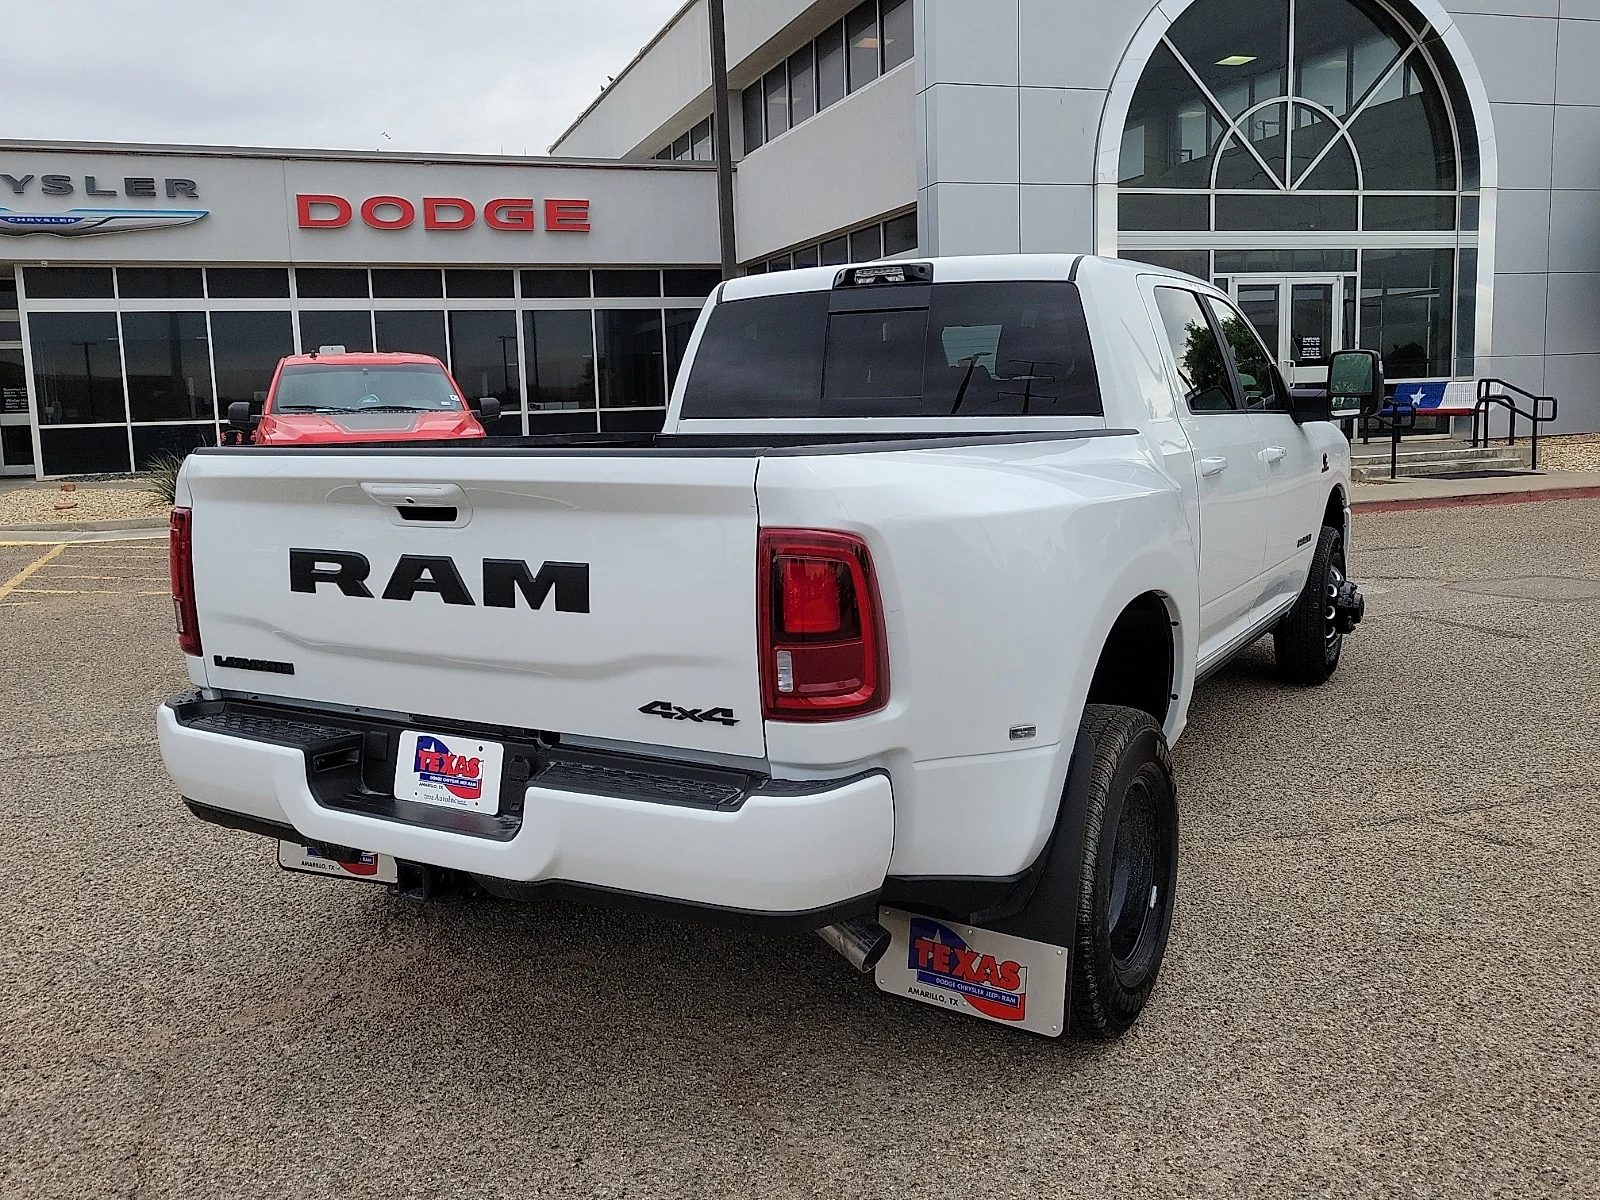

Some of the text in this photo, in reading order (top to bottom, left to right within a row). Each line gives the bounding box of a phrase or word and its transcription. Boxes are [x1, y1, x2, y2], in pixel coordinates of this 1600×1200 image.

[296, 193, 590, 232] DODGE
[289, 547, 590, 613] RAM
[418, 749, 480, 778] TEXAS
[915, 939, 1021, 991] TEXAS
[908, 987, 959, 1006] AMARILLO, TX
[936, 977, 956, 988] DODGE
[956, 983, 984, 996] CHRYSLER
[1001, 995, 1016, 1004] RAM
